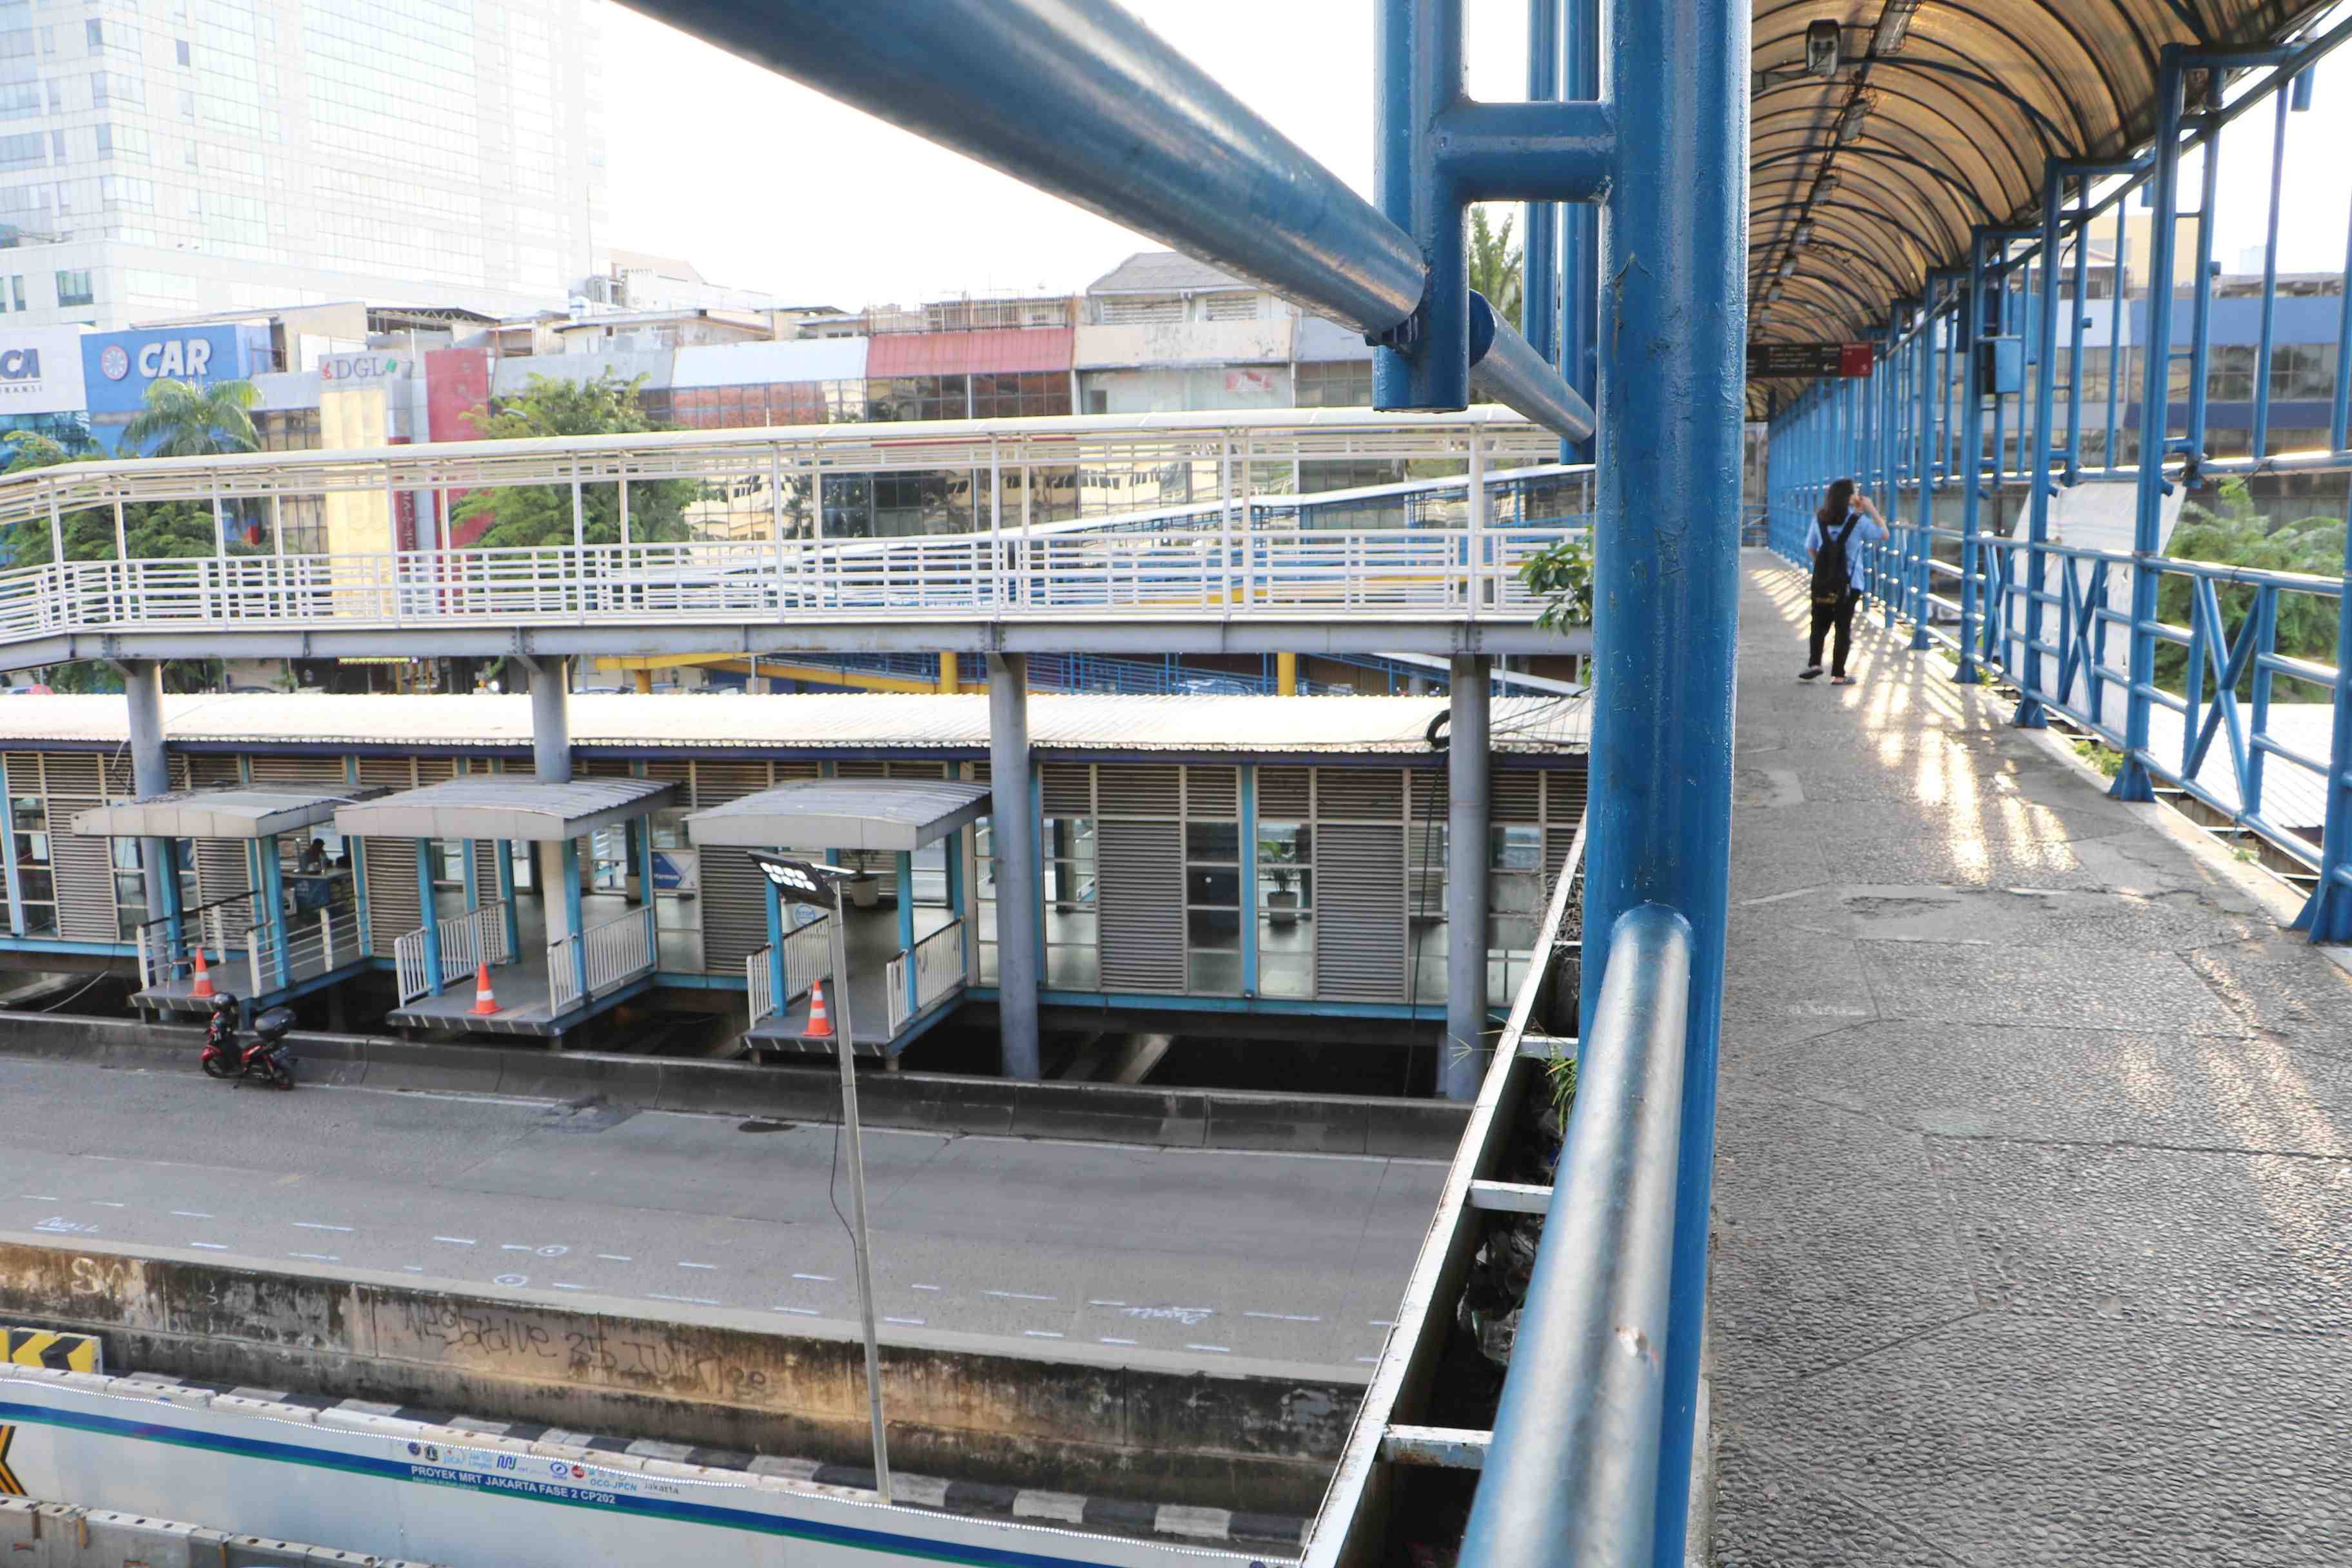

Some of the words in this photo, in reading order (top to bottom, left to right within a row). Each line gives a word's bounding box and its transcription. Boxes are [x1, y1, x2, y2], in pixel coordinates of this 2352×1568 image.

[138, 338, 211, 379] CAR
[335, 357, 386, 381] DGL
[411, 1465, 458, 1481] PROYEK
[458, 1471, 482, 1484] MRT
[485, 1476, 537, 1493] JAKARTA
[539, 1484, 568, 1498] FASE
[571, 1489, 578, 1499] 2
[580, 1490, 616, 1504] CP202
